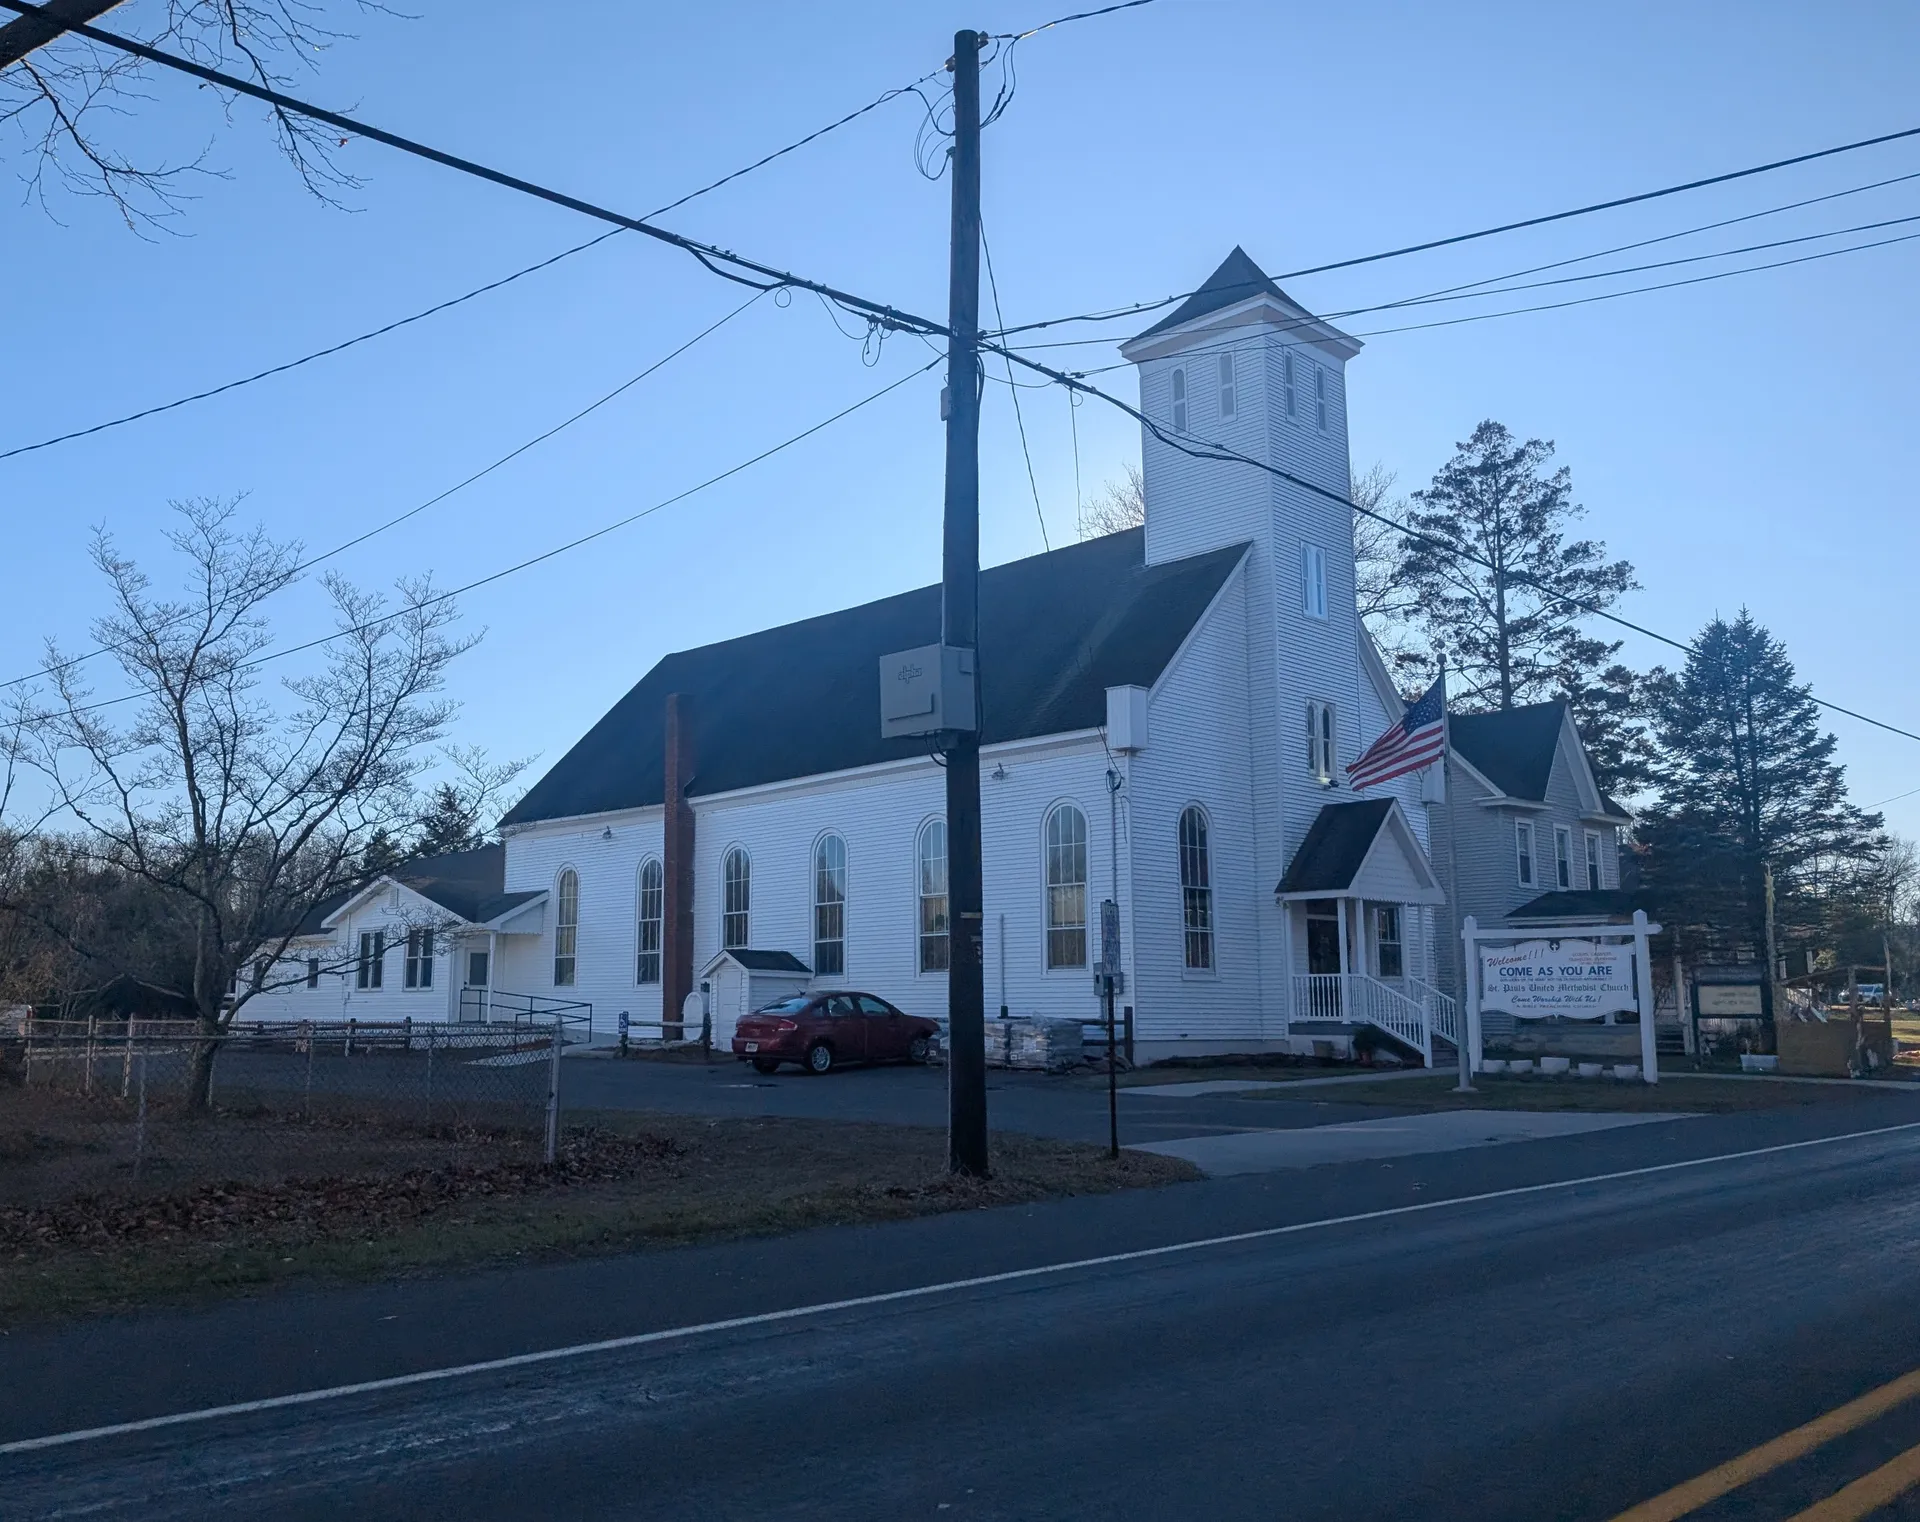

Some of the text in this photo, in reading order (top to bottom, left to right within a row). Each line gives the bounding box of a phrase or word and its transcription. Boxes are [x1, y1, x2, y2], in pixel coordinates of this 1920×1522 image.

[1486, 948, 1544, 967] Welcome!!!
[1499, 966, 1613, 977] COME AS YOU ARE
[1487, 983, 1629, 993] St. Pauls United Methodist Church
[1511, 995, 1531, 1003] Come
[1532, 995, 1562, 1003] Worship
[1563, 995, 1583, 1003] With
